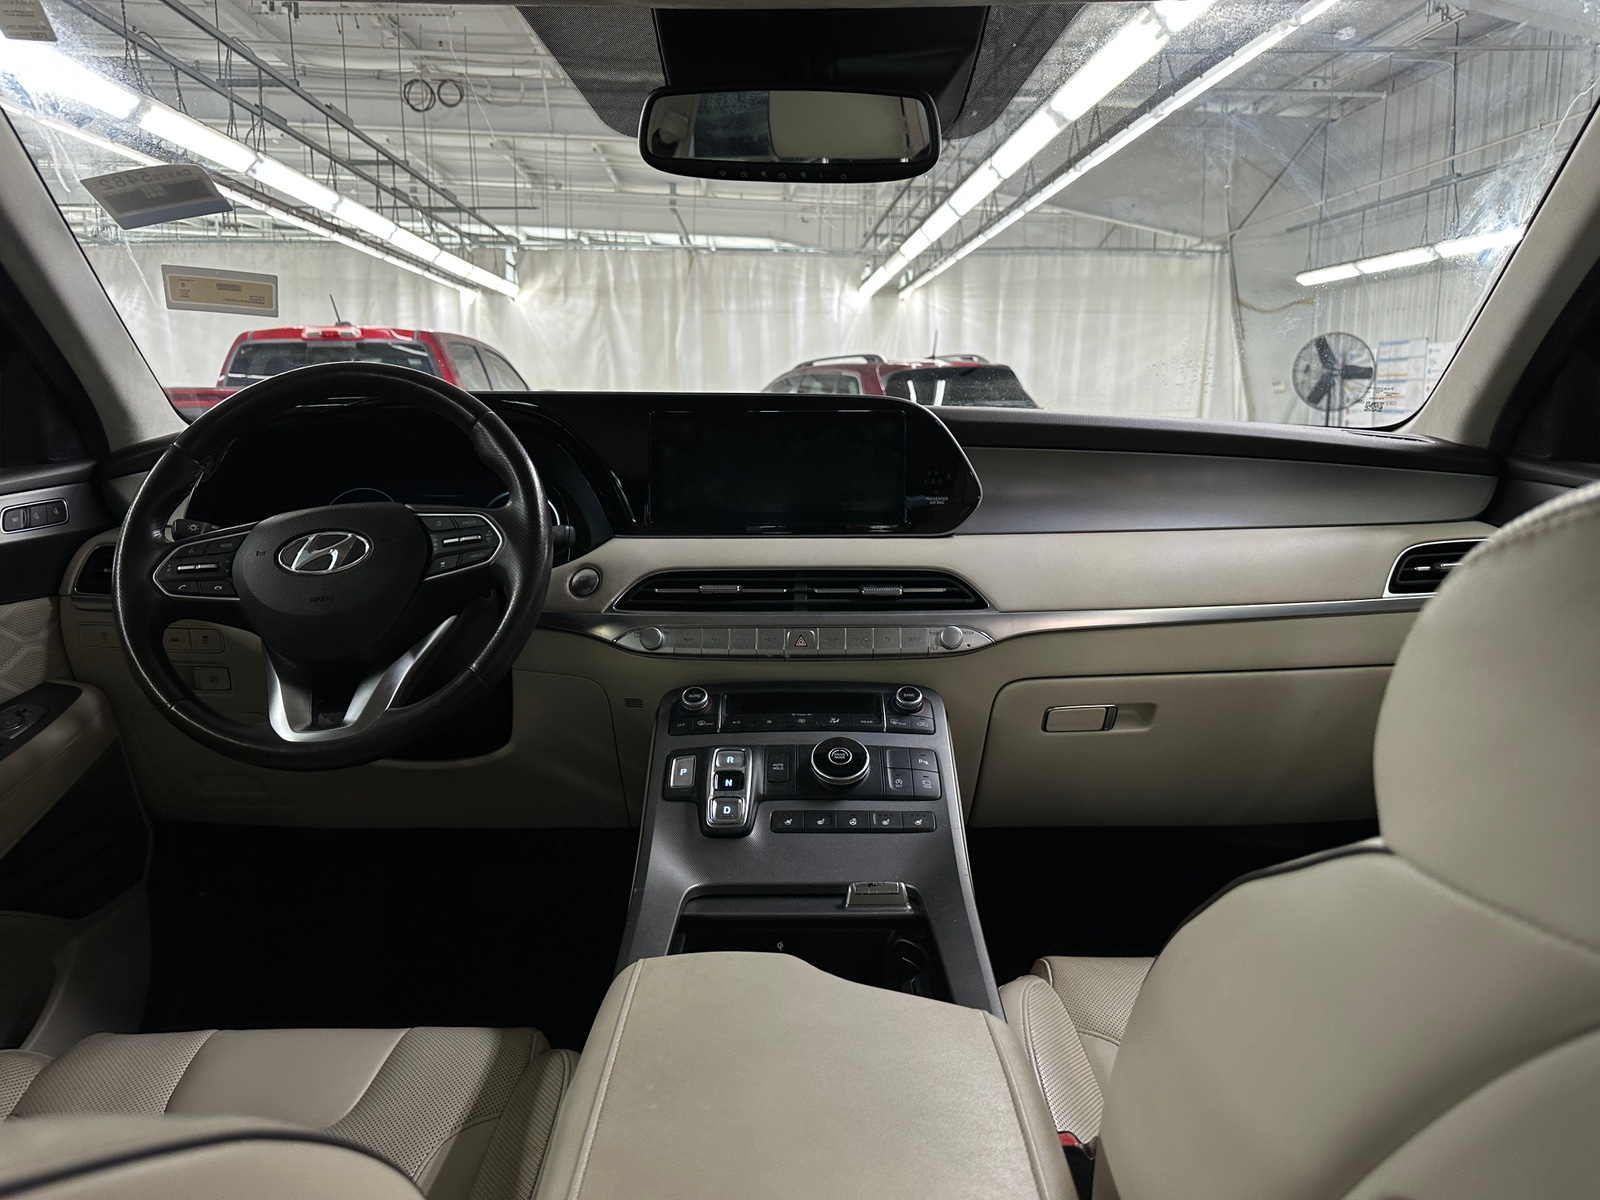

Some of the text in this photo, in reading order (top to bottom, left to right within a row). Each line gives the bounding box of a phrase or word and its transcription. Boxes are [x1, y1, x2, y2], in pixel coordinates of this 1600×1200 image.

[309, 594, 336, 604] AIRBAG
[726, 756, 734, 764] R
[680, 768, 688, 776] P
[724, 778, 733, 787] N
[723, 806, 731, 814] D
